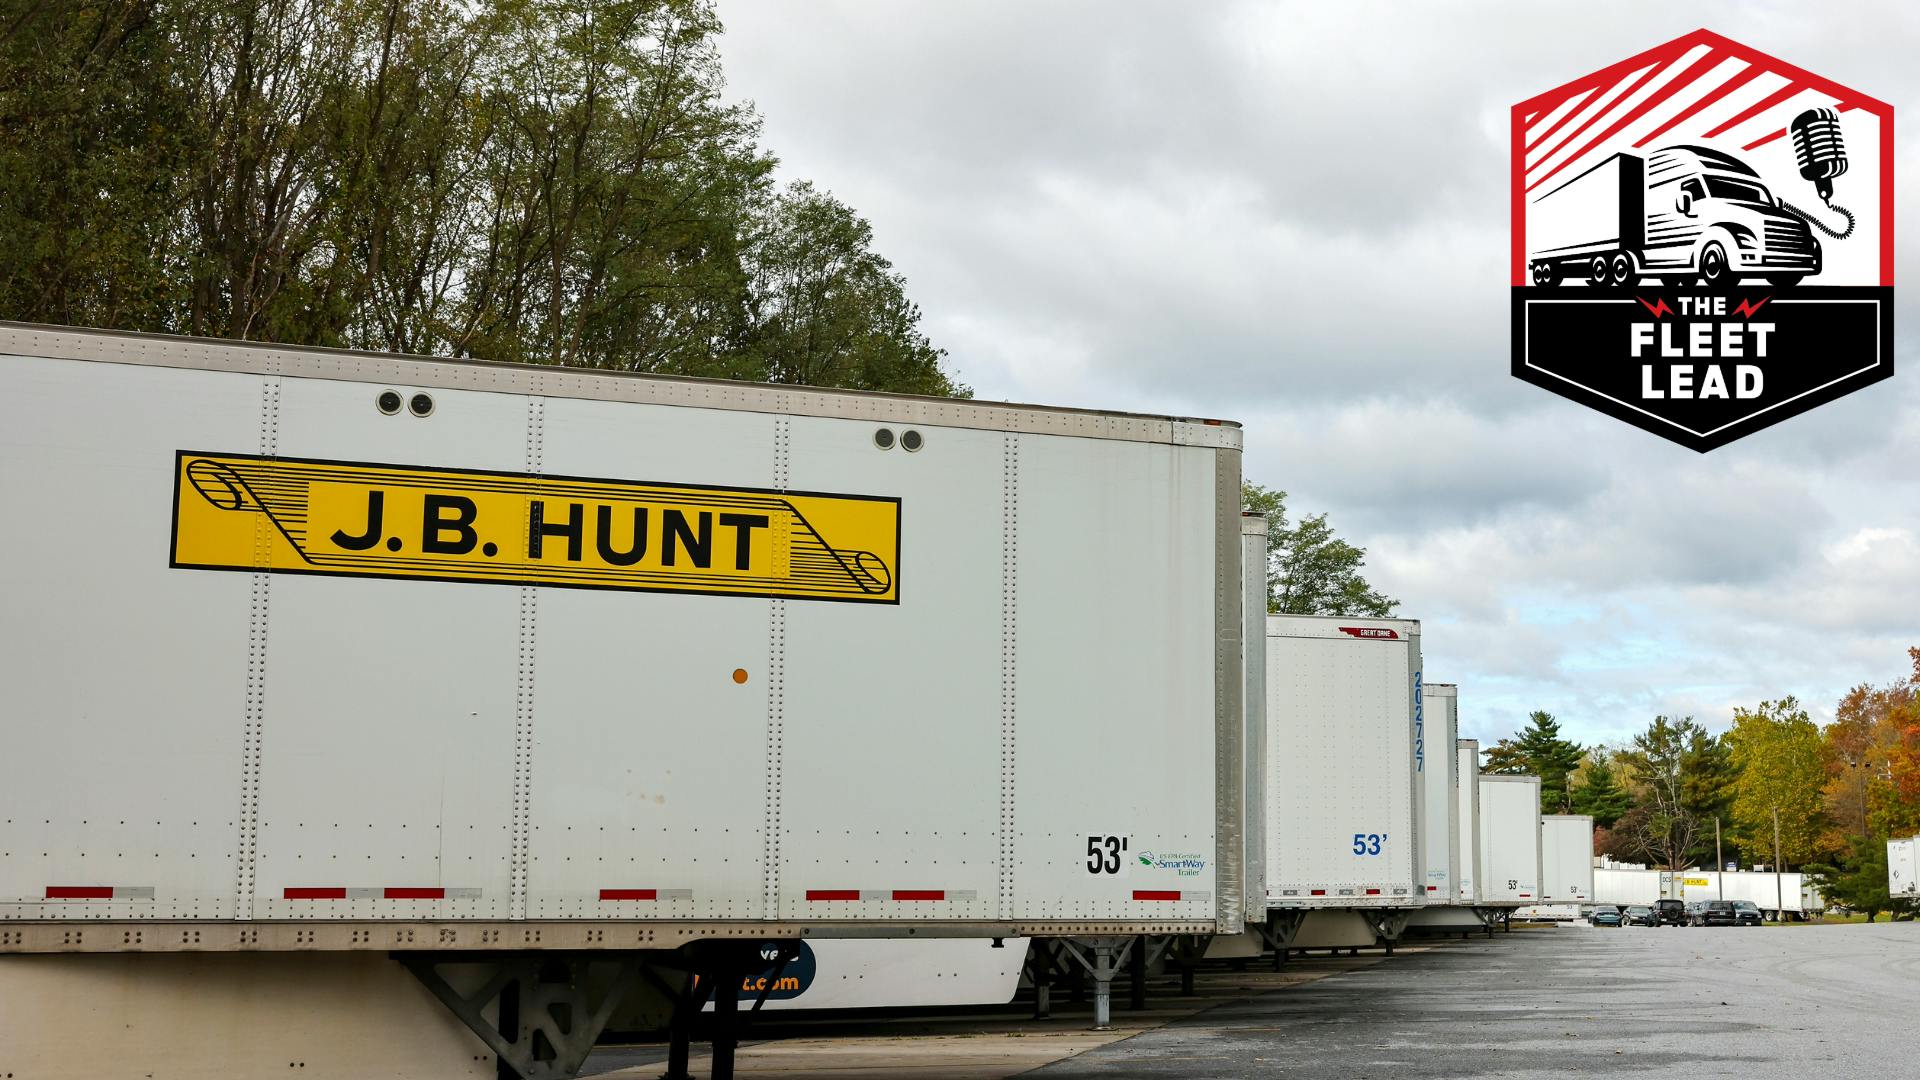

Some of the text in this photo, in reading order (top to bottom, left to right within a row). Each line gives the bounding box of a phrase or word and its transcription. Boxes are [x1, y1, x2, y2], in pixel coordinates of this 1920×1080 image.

[330, 491, 769, 570] J.B. HUNT
[1415, 672, 1424, 772] 202727
[1087, 836, 1128, 875] 53'
[1160, 859, 1205, 870] SmartWay
